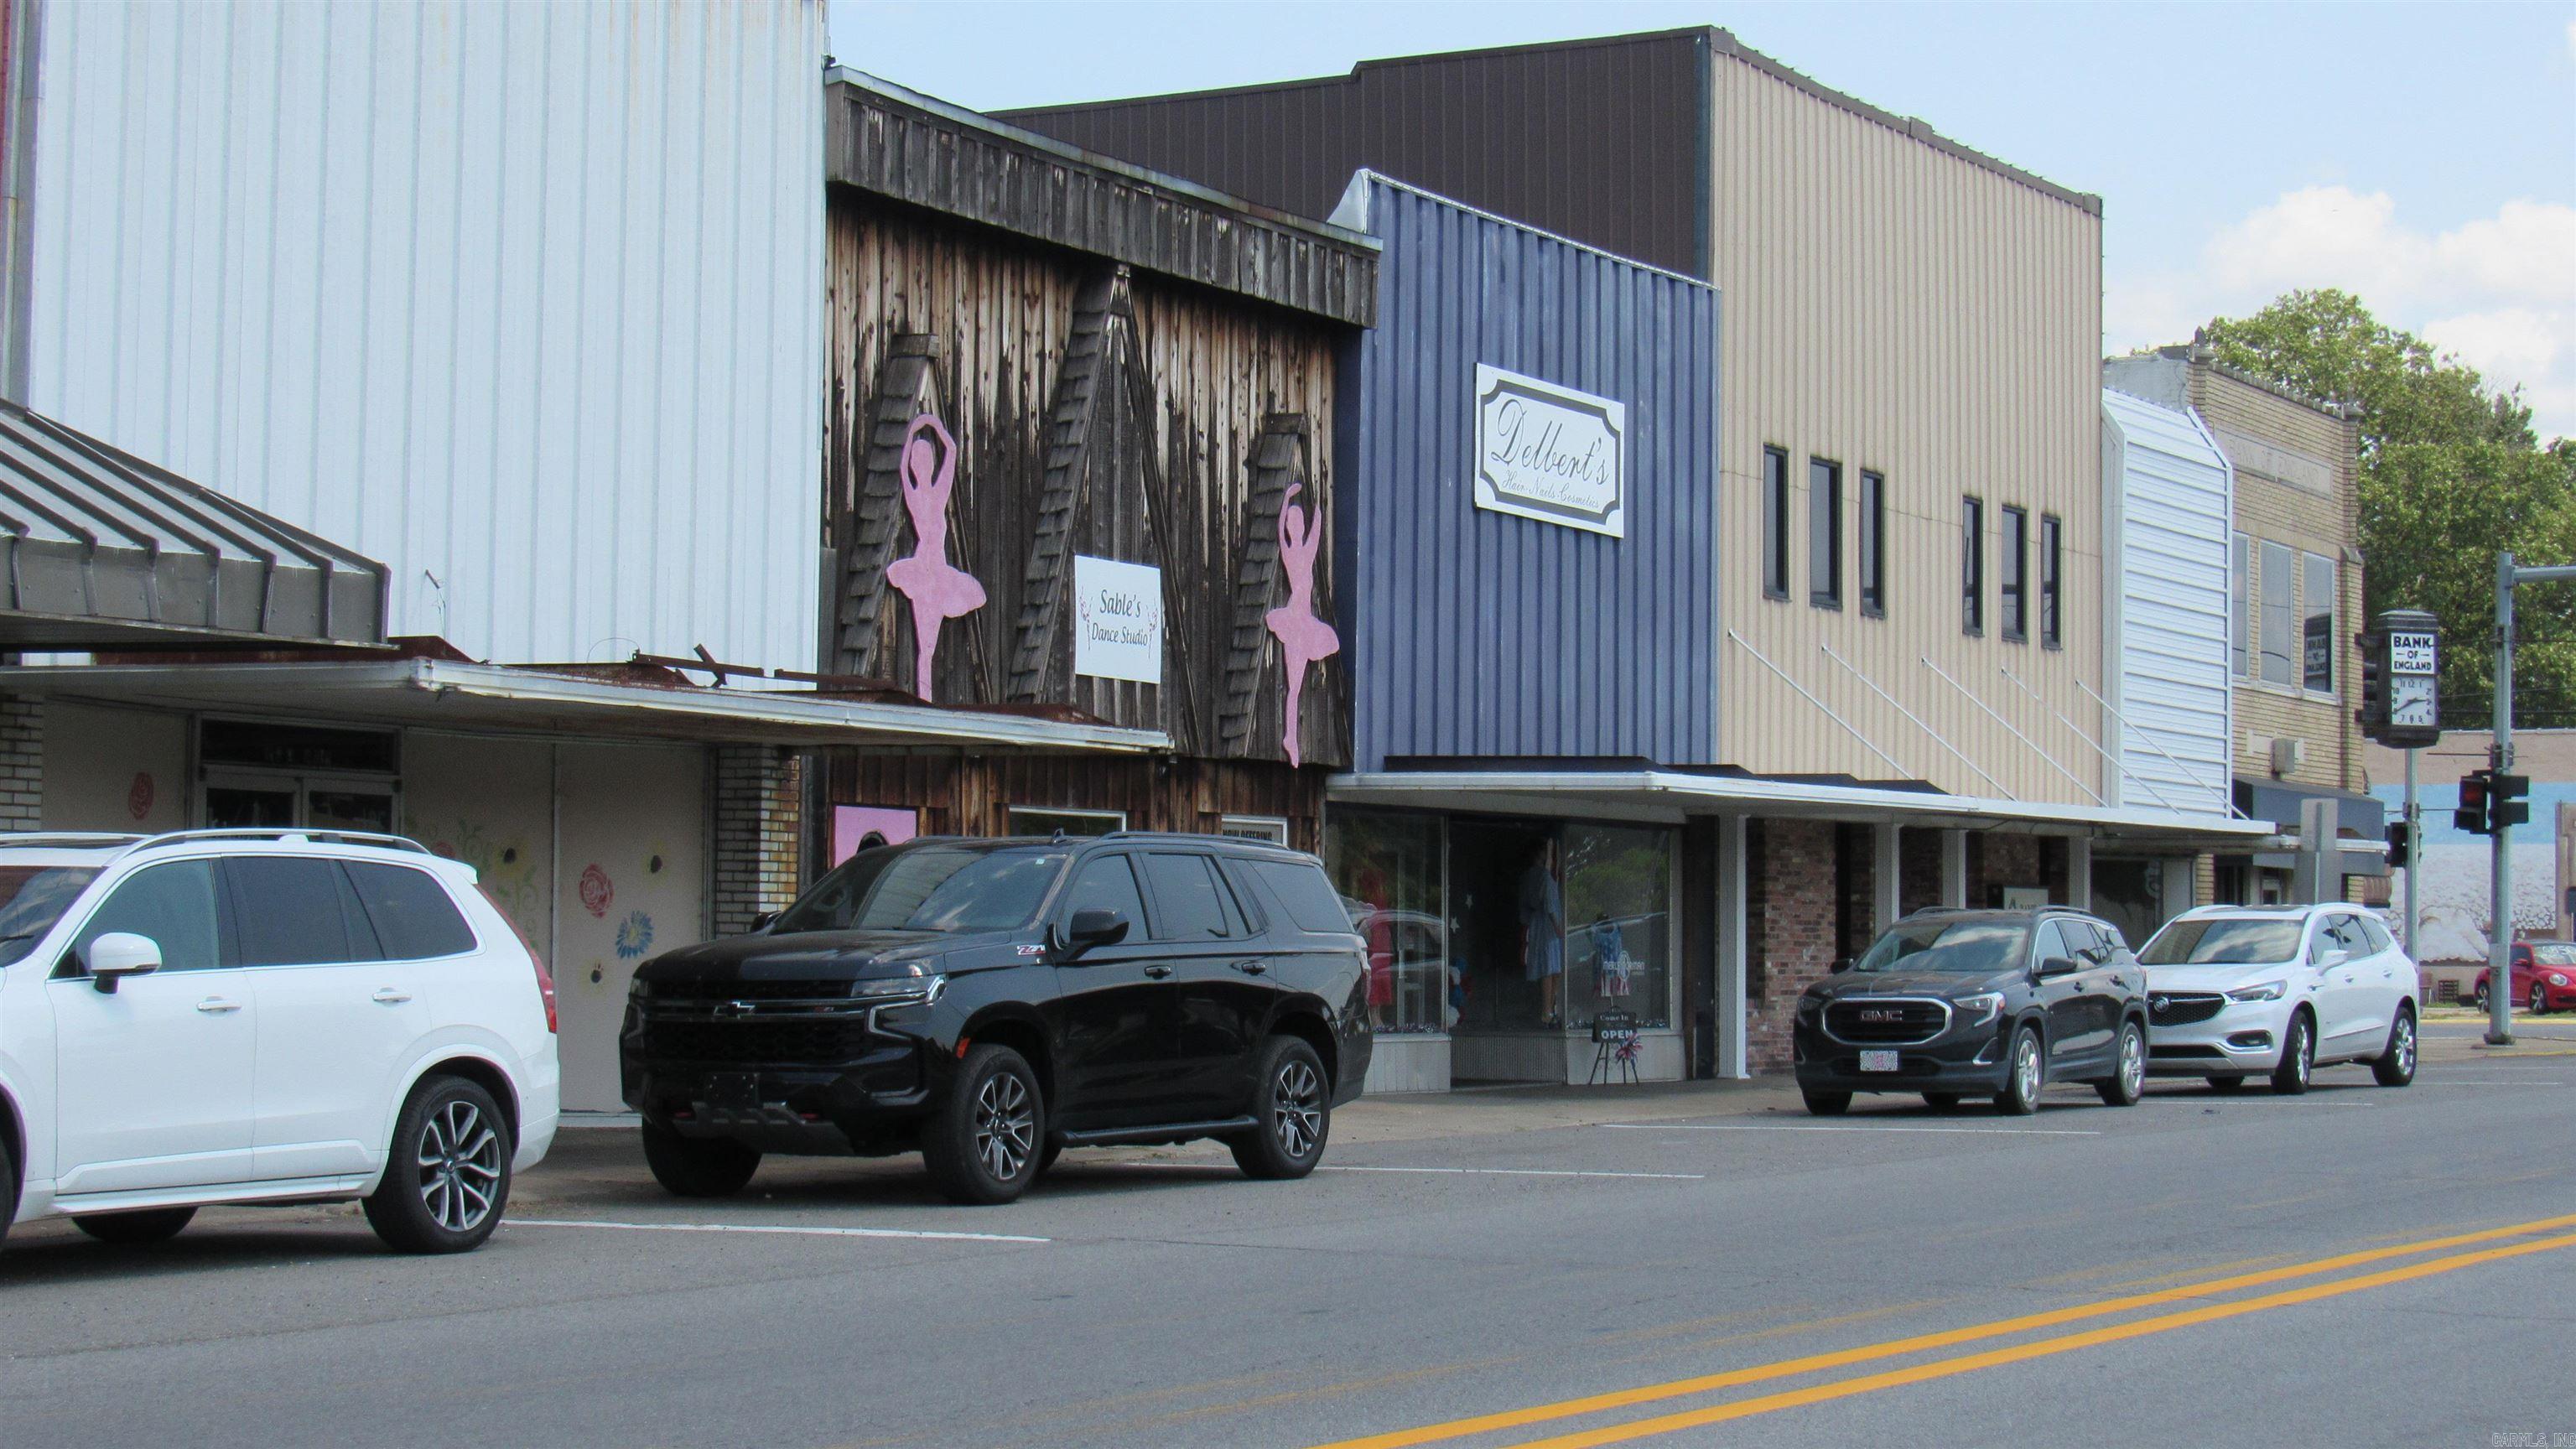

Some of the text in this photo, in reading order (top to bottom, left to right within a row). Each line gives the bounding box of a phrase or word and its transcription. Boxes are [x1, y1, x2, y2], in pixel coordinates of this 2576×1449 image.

[1491, 398, 1609, 486] Delbert's
[1099, 589, 1141, 617] Sable's
[1092, 622, 1149, 647] Dance Studio
[2393, 636, 2432, 648] BANK
[2407, 651, 2418, 659] OF
[2394, 662, 2432, 671] ENGLAND
[1860, 1010, 1903, 1021] GMC
[1601, 1030, 1633, 1039] OPEN
